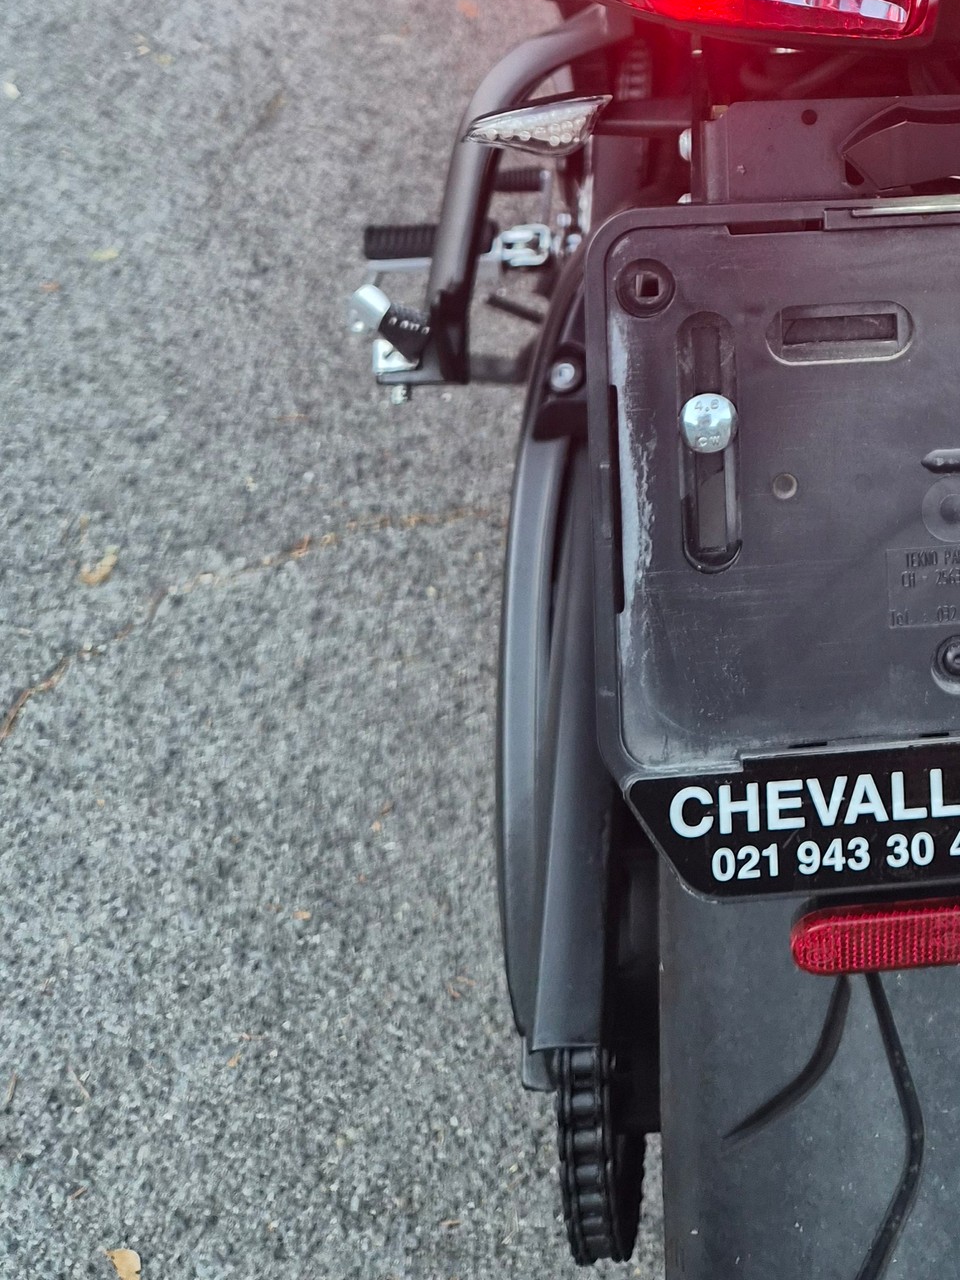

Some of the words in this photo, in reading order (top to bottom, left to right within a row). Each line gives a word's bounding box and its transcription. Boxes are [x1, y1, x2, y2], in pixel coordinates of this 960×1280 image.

[905, 549, 939, 568] TEKNO
[901, 570, 917, 588] CH
[711, 842, 779, 882] 021
[796, 836, 871, 875] 943
[886, 831, 935, 867] 30
